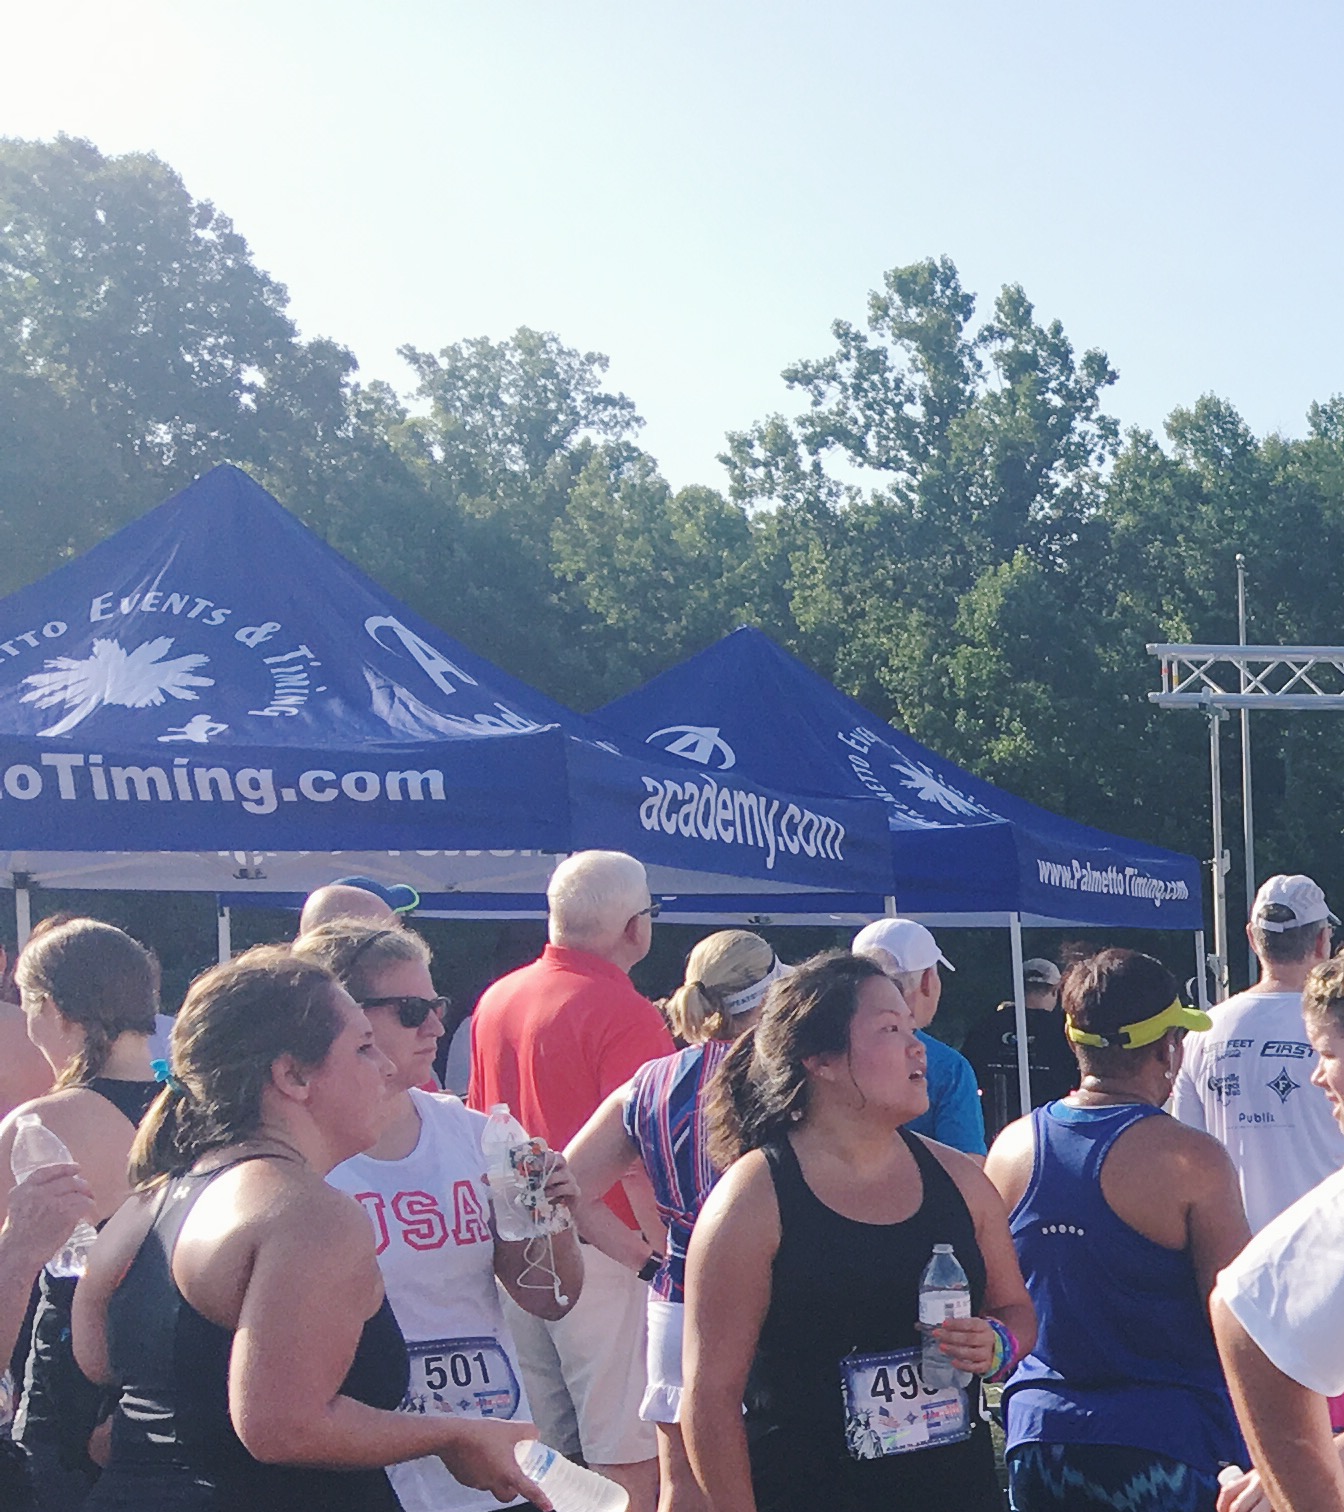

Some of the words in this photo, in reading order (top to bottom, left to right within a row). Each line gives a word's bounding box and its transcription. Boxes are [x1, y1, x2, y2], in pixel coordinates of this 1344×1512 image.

[90, 591, 232, 625] EVENTS
[0, 621, 68, 664] TTO
[234, 621, 281, 648] &
[248, 644, 327, 717] TIMING
[0, 753, 447, 815] oTiming.com
[639, 773, 846, 870] academy.com
[1036, 858, 1189, 908] www.PalmettoTiming.com
[1226, 1039, 1255, 1048] FEET
[424, 1351, 490, 1390] 501
